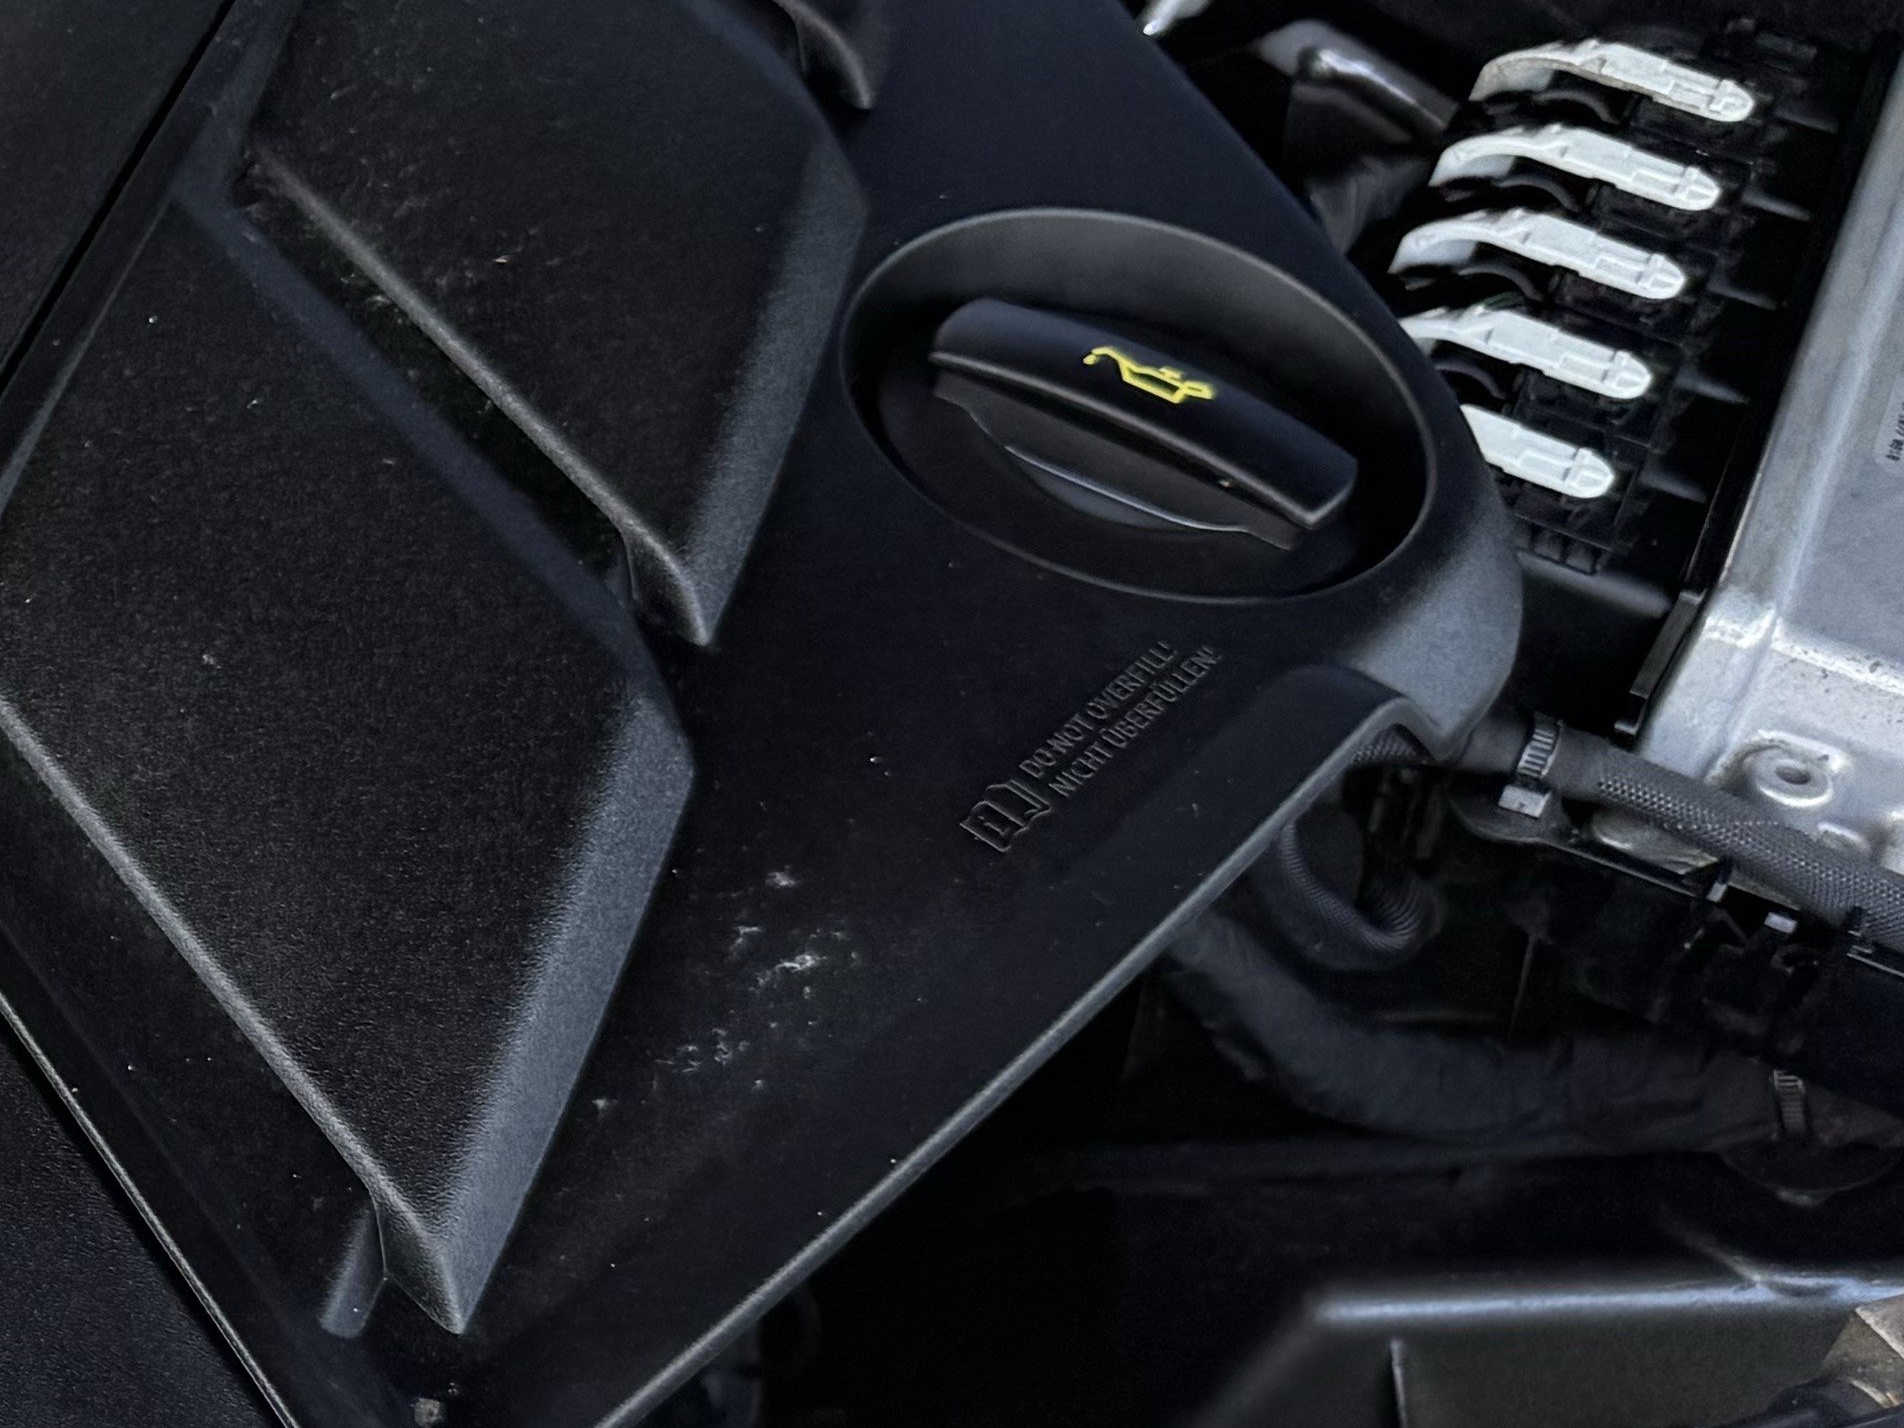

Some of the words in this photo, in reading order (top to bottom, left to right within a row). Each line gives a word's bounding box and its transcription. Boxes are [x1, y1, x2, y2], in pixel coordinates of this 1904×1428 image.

[1019, 748, 1056, 778] DO
[1046, 712, 1094, 754] NOT
[1048, 741, 1113, 798] NICHT
